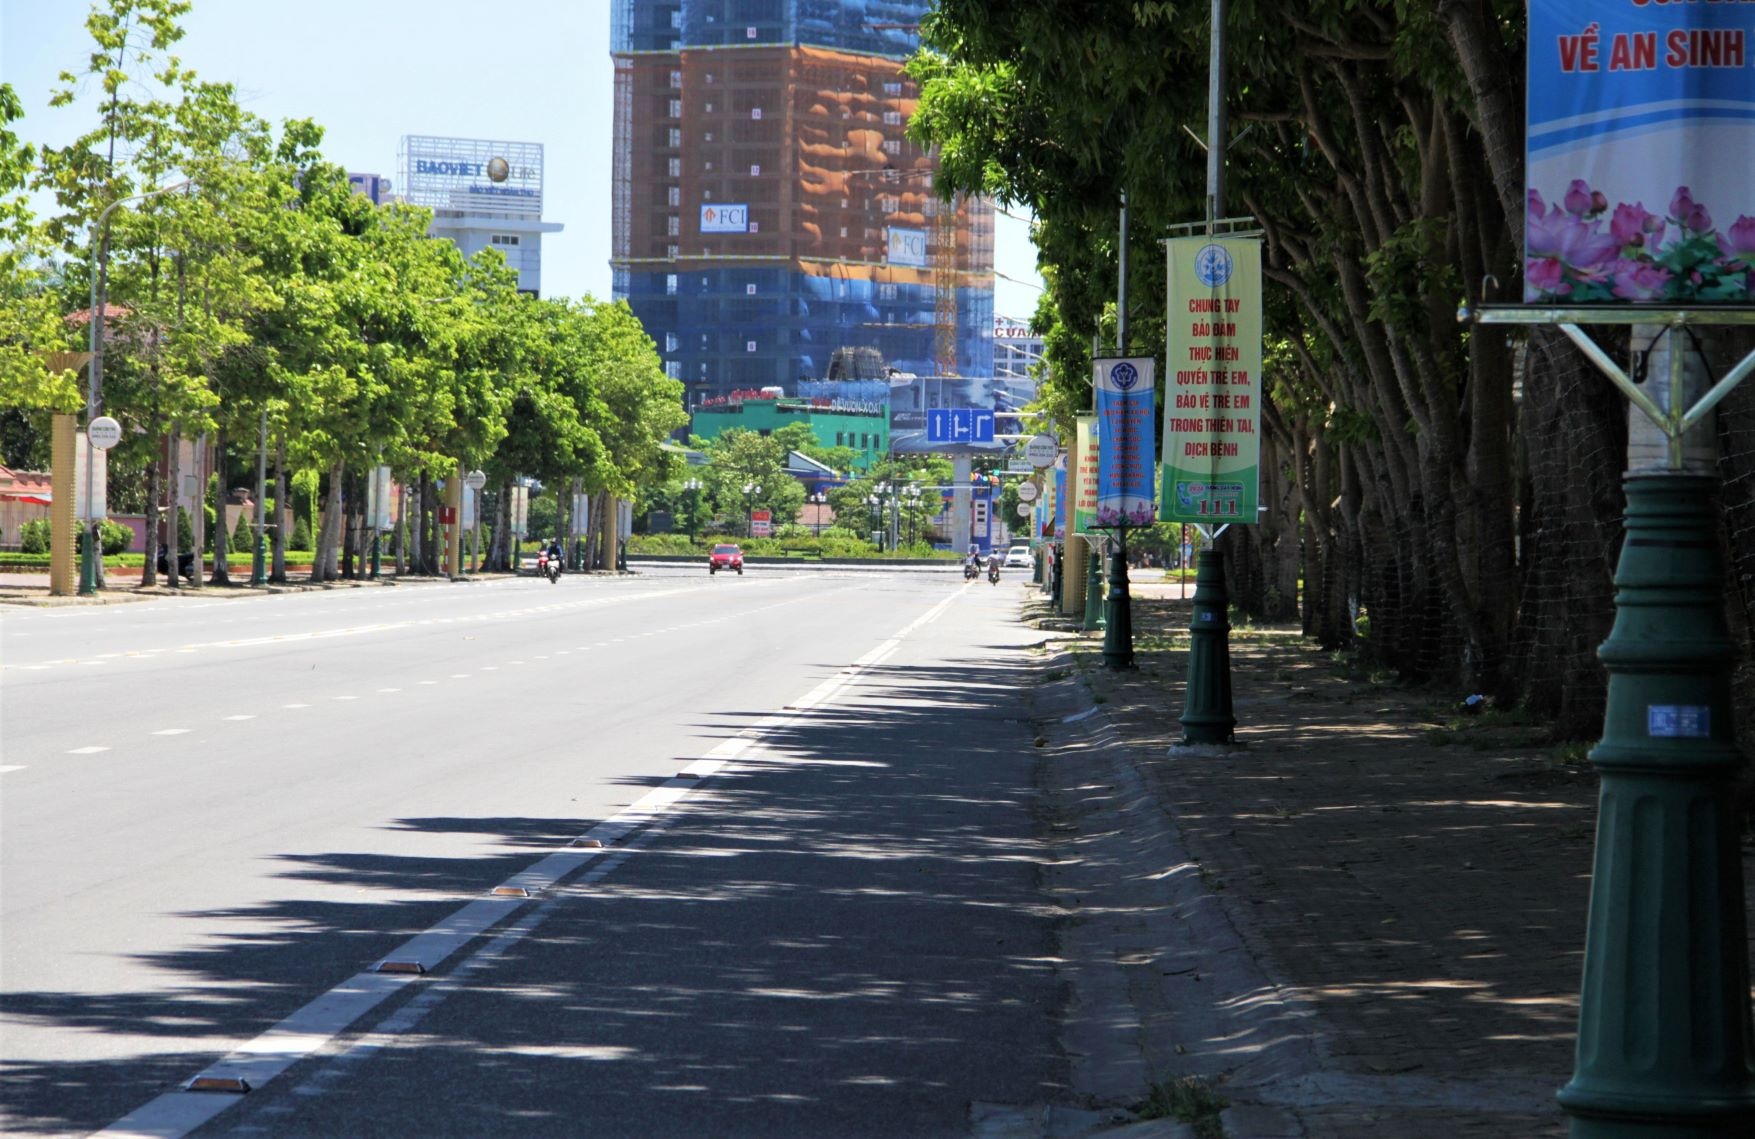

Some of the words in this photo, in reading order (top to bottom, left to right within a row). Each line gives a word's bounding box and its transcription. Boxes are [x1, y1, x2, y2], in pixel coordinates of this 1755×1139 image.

[1558, 22, 1599, 72] VỀ
[1608, 32, 1656, 71] AN
[1665, 29, 1745, 69] SINH
[720, 209, 744, 225] FCI
[1188, 299, 1221, 313] CHUNG
[1224, 299, 1240, 313] TAY
[1192, 318, 1210, 337] BẢO
[1212, 318, 1236, 337] ĐẢM
[1189, 346, 1212, 364] THỰC
[1214, 344, 1239, 364] HIỆN
[1211, 367, 1228, 385] TRẺ
[1231, 370, 1251, 386] EM,
[1176, 389, 1196, 409] BẢO
[1199, 391, 1209, 412] VỆ
[1213, 390, 1230, 409] TRẺ
[1234, 394, 1250, 409] EM
[1170, 418, 1203, 432] TRONG
[1205, 416, 1234, 432] THIÊN
[1237, 418, 1254, 435] TAI,
[1184, 442, 1208, 460] DỊCH
[1210, 440, 1238, 460] BỆNH
[1199, 499, 1239, 515] 111
